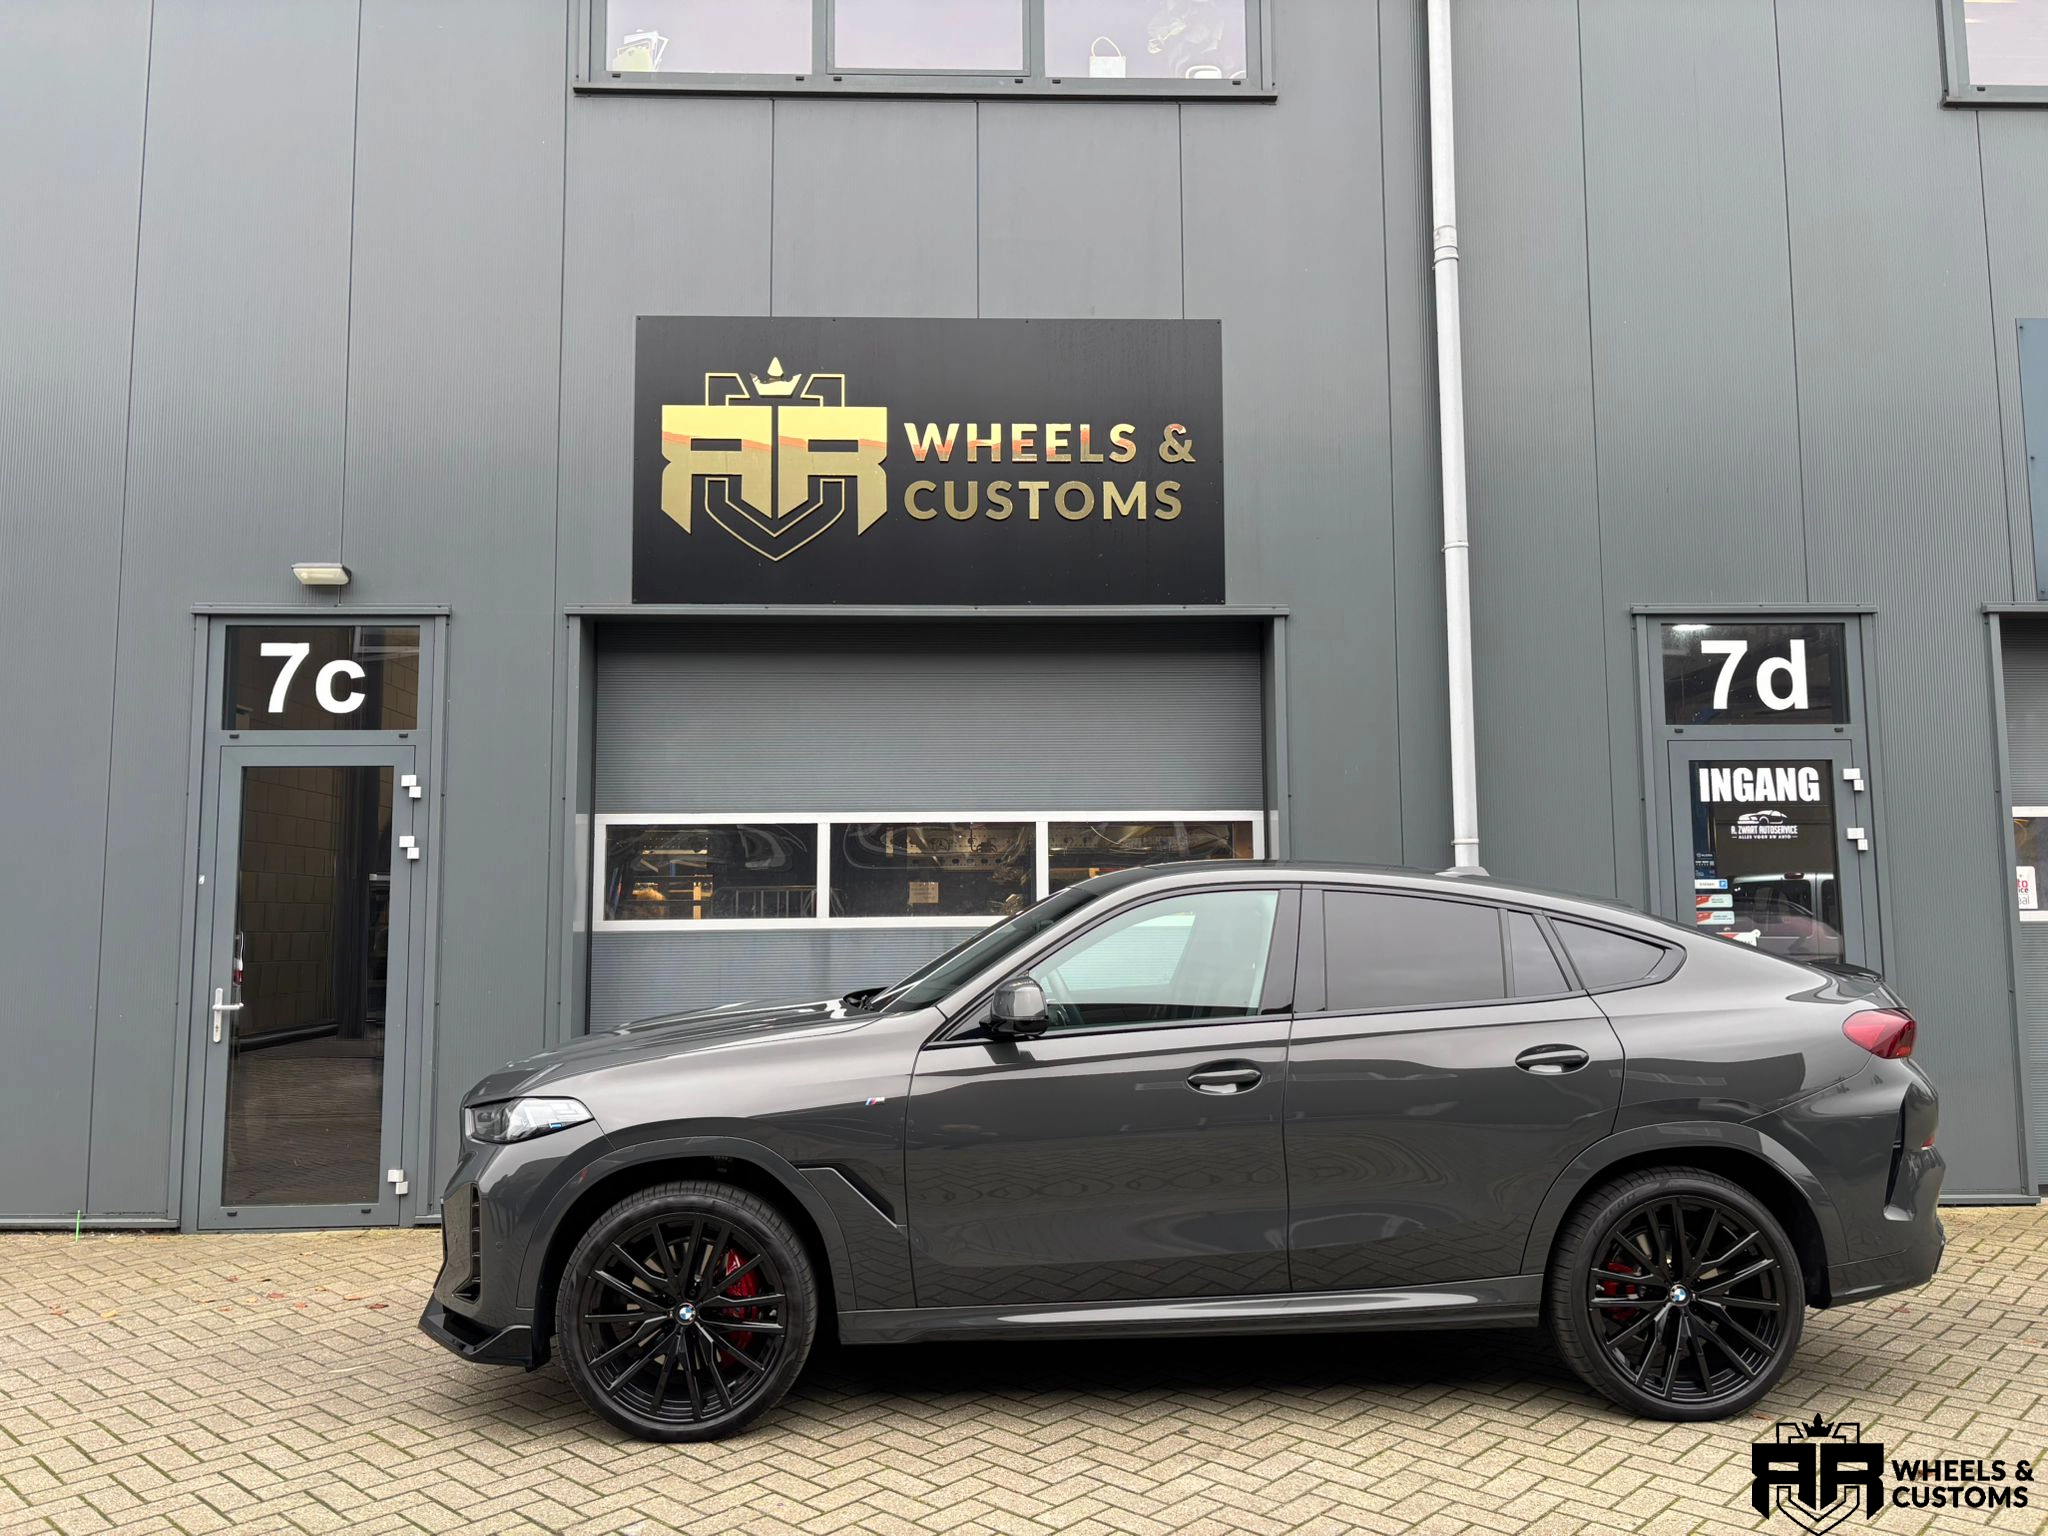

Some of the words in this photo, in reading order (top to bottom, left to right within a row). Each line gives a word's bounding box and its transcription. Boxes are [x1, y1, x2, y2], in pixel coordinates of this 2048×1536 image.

[903, 422, 1137, 463] WHEELS
[1158, 422, 1197, 463] &
[903, 480, 1182, 520] CUSTOMS
[260, 642, 366, 714] 7c
[1700, 639, 1809, 711] 7d
[1698, 767, 1821, 803] INGANG
[1738, 825, 1758, 835] ZWART
[1759, 825, 1798, 835] AUTOSERVICE
